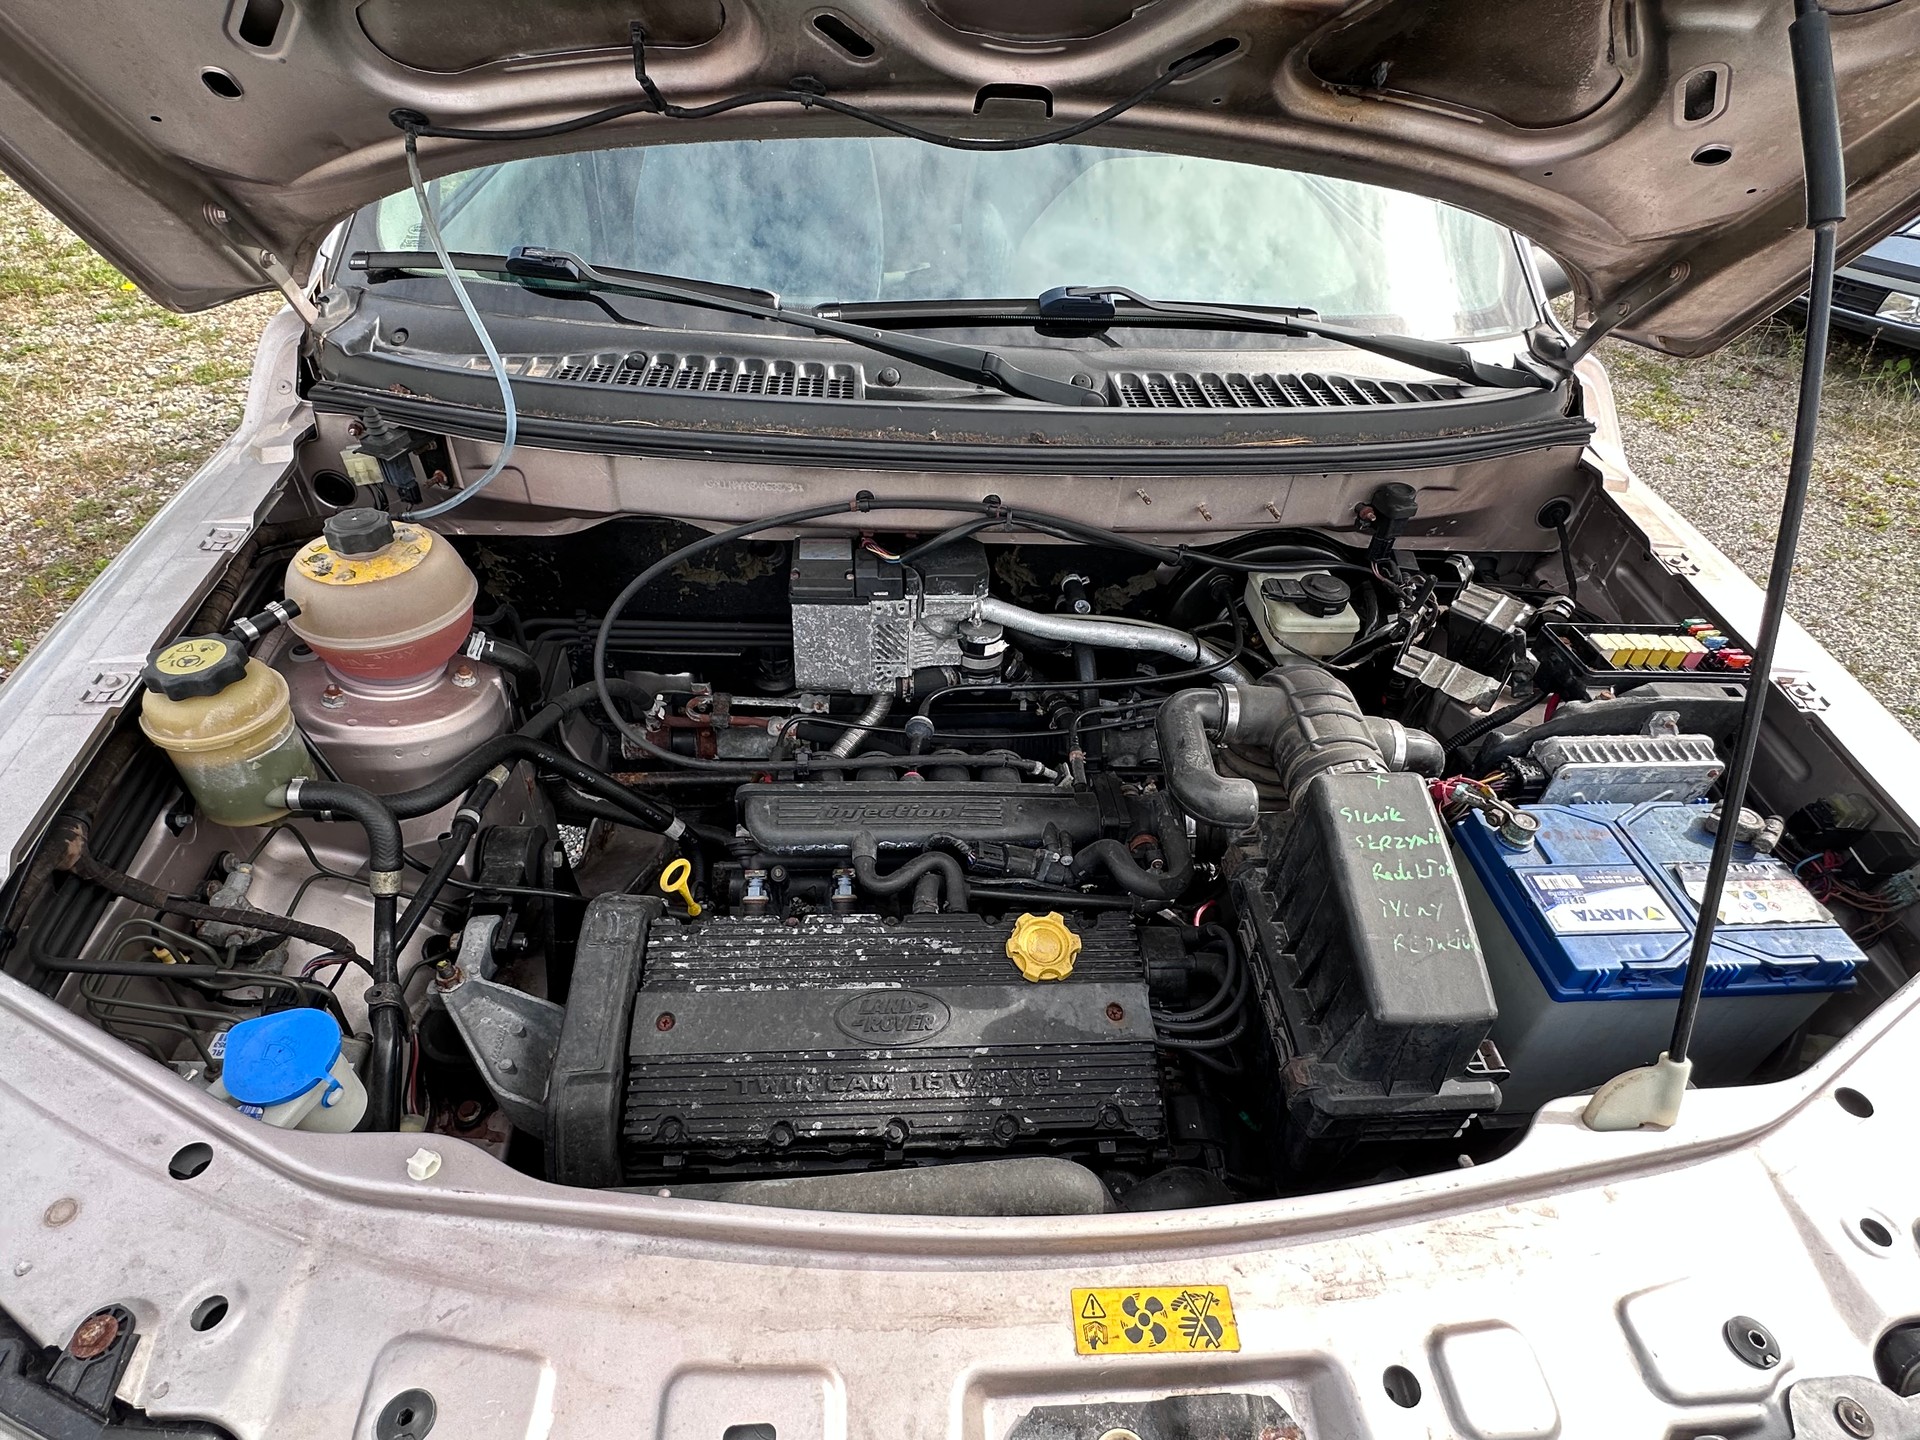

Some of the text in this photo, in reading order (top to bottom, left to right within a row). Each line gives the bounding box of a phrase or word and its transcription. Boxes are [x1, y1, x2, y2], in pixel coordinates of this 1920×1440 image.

[826, 803, 953, 822] injection
[1570, 908, 1644, 921] VARTA
[733, 1077, 814, 1095] TWIN
[826, 1074, 895, 1093] CAM
